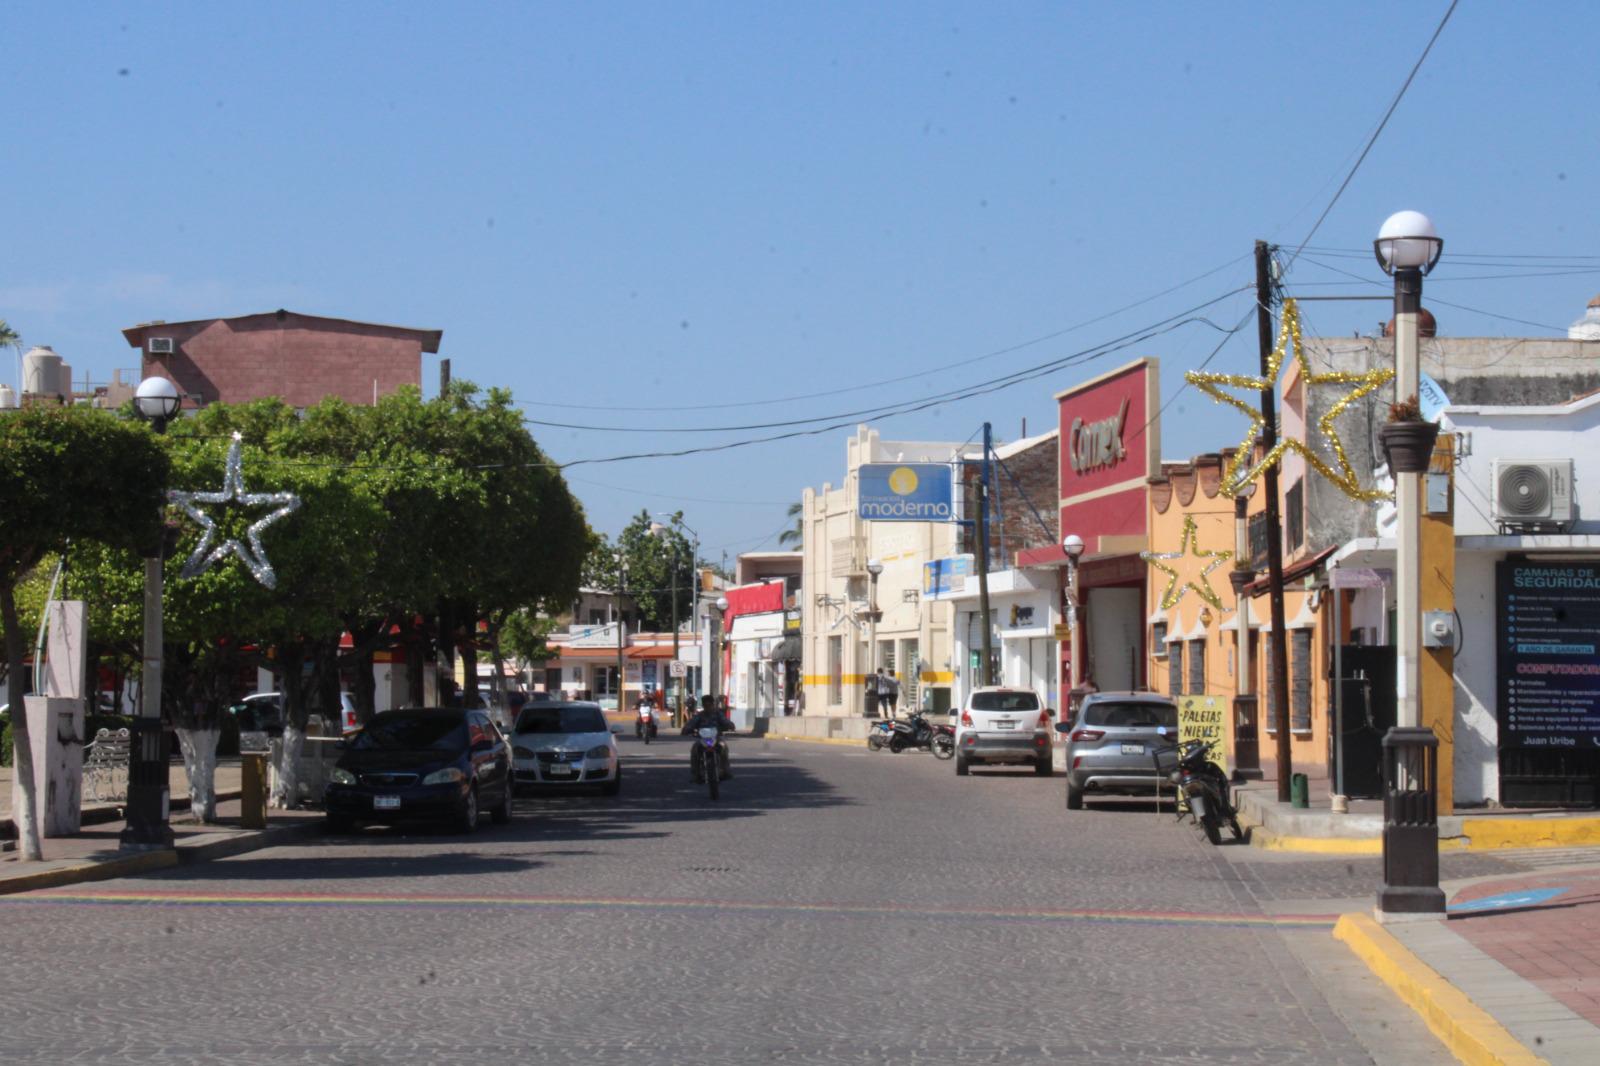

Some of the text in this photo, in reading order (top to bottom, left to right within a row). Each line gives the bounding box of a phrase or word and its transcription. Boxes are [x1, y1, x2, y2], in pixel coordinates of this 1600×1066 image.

[1069, 396, 1127, 472] Comex
[861, 499, 949, 516] moderna
[1514, 568, 1594, 578] CAMARAS DE
[1182, 711, 1222, 723] PALETAS
[1184, 726, 1220, 738] NIEVES
[1523, 736, 1575, 746] Juan Uribe
